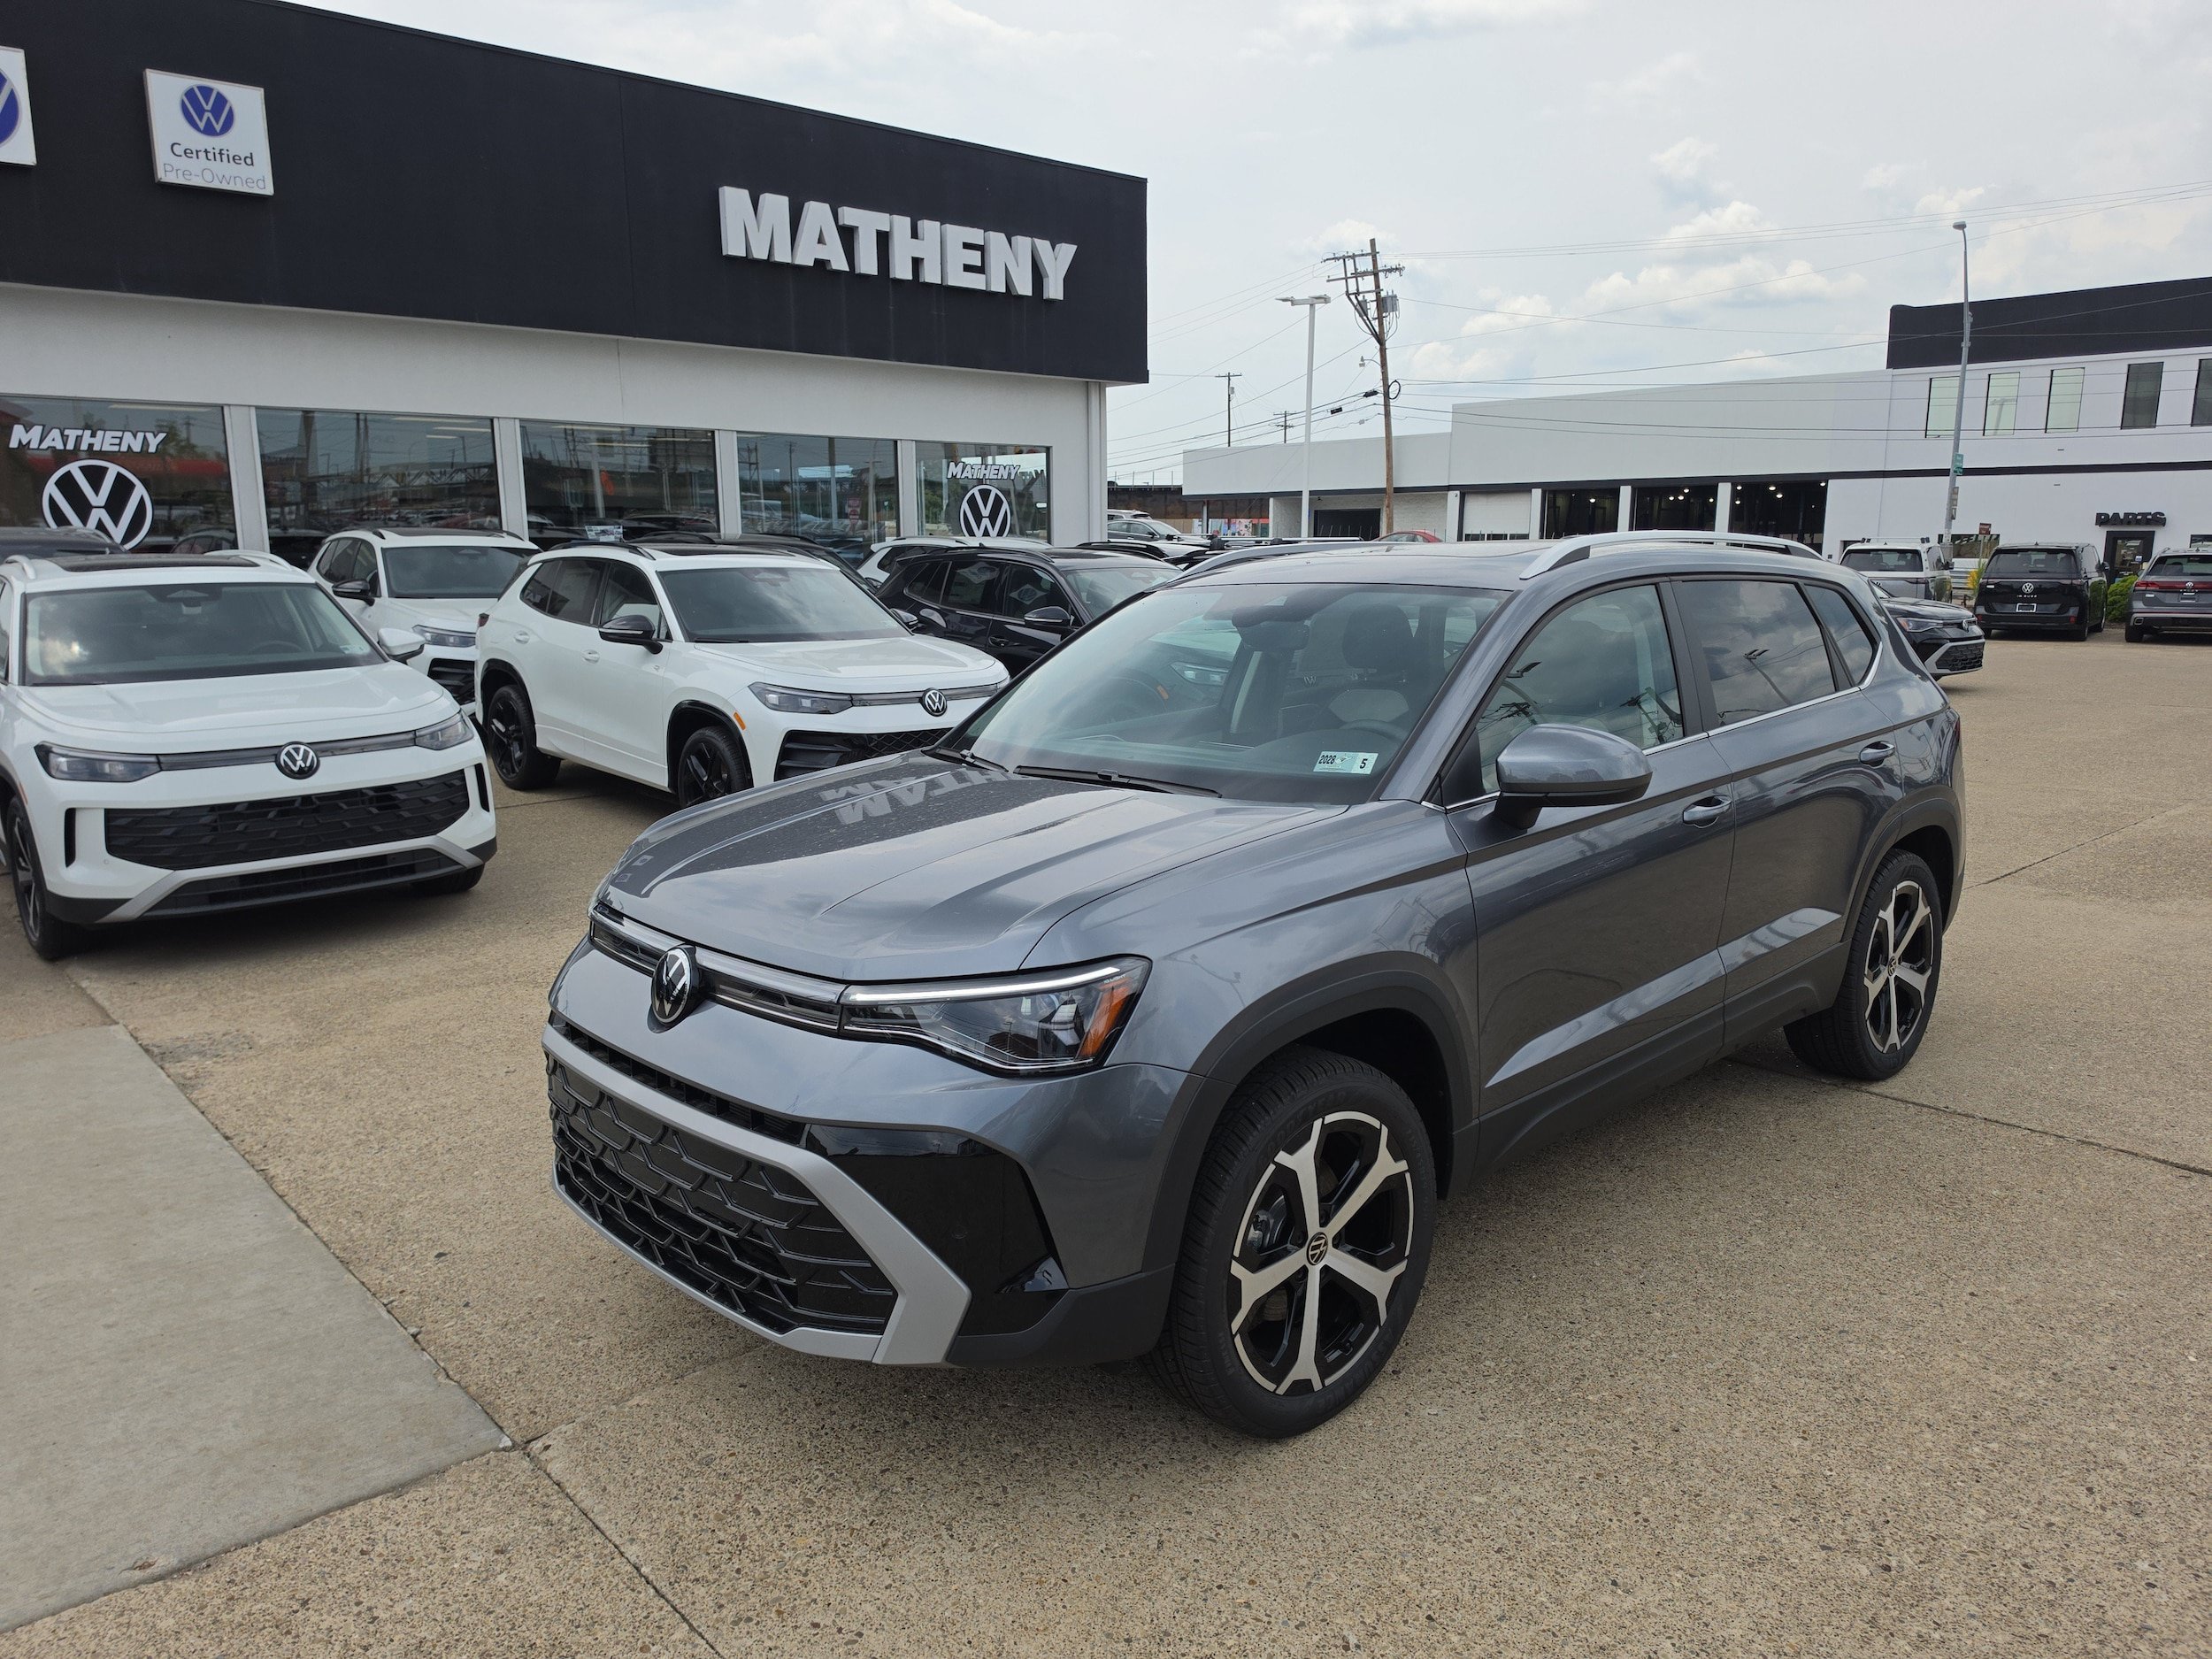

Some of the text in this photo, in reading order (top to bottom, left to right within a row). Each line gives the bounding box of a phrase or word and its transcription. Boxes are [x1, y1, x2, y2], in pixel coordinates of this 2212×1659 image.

[171, 142, 255, 166] Certified
[163, 163, 267, 190] Pre-Owned
[718, 186, 1078, 301] MATHENY
[8, 424, 167, 453] MATHENY
[947, 462, 1020, 480] MATHENY
[2094, 511, 2167, 526] PARTS
[1318, 755, 1337, 764] 2028
[1360, 758, 1369, 770] 5
